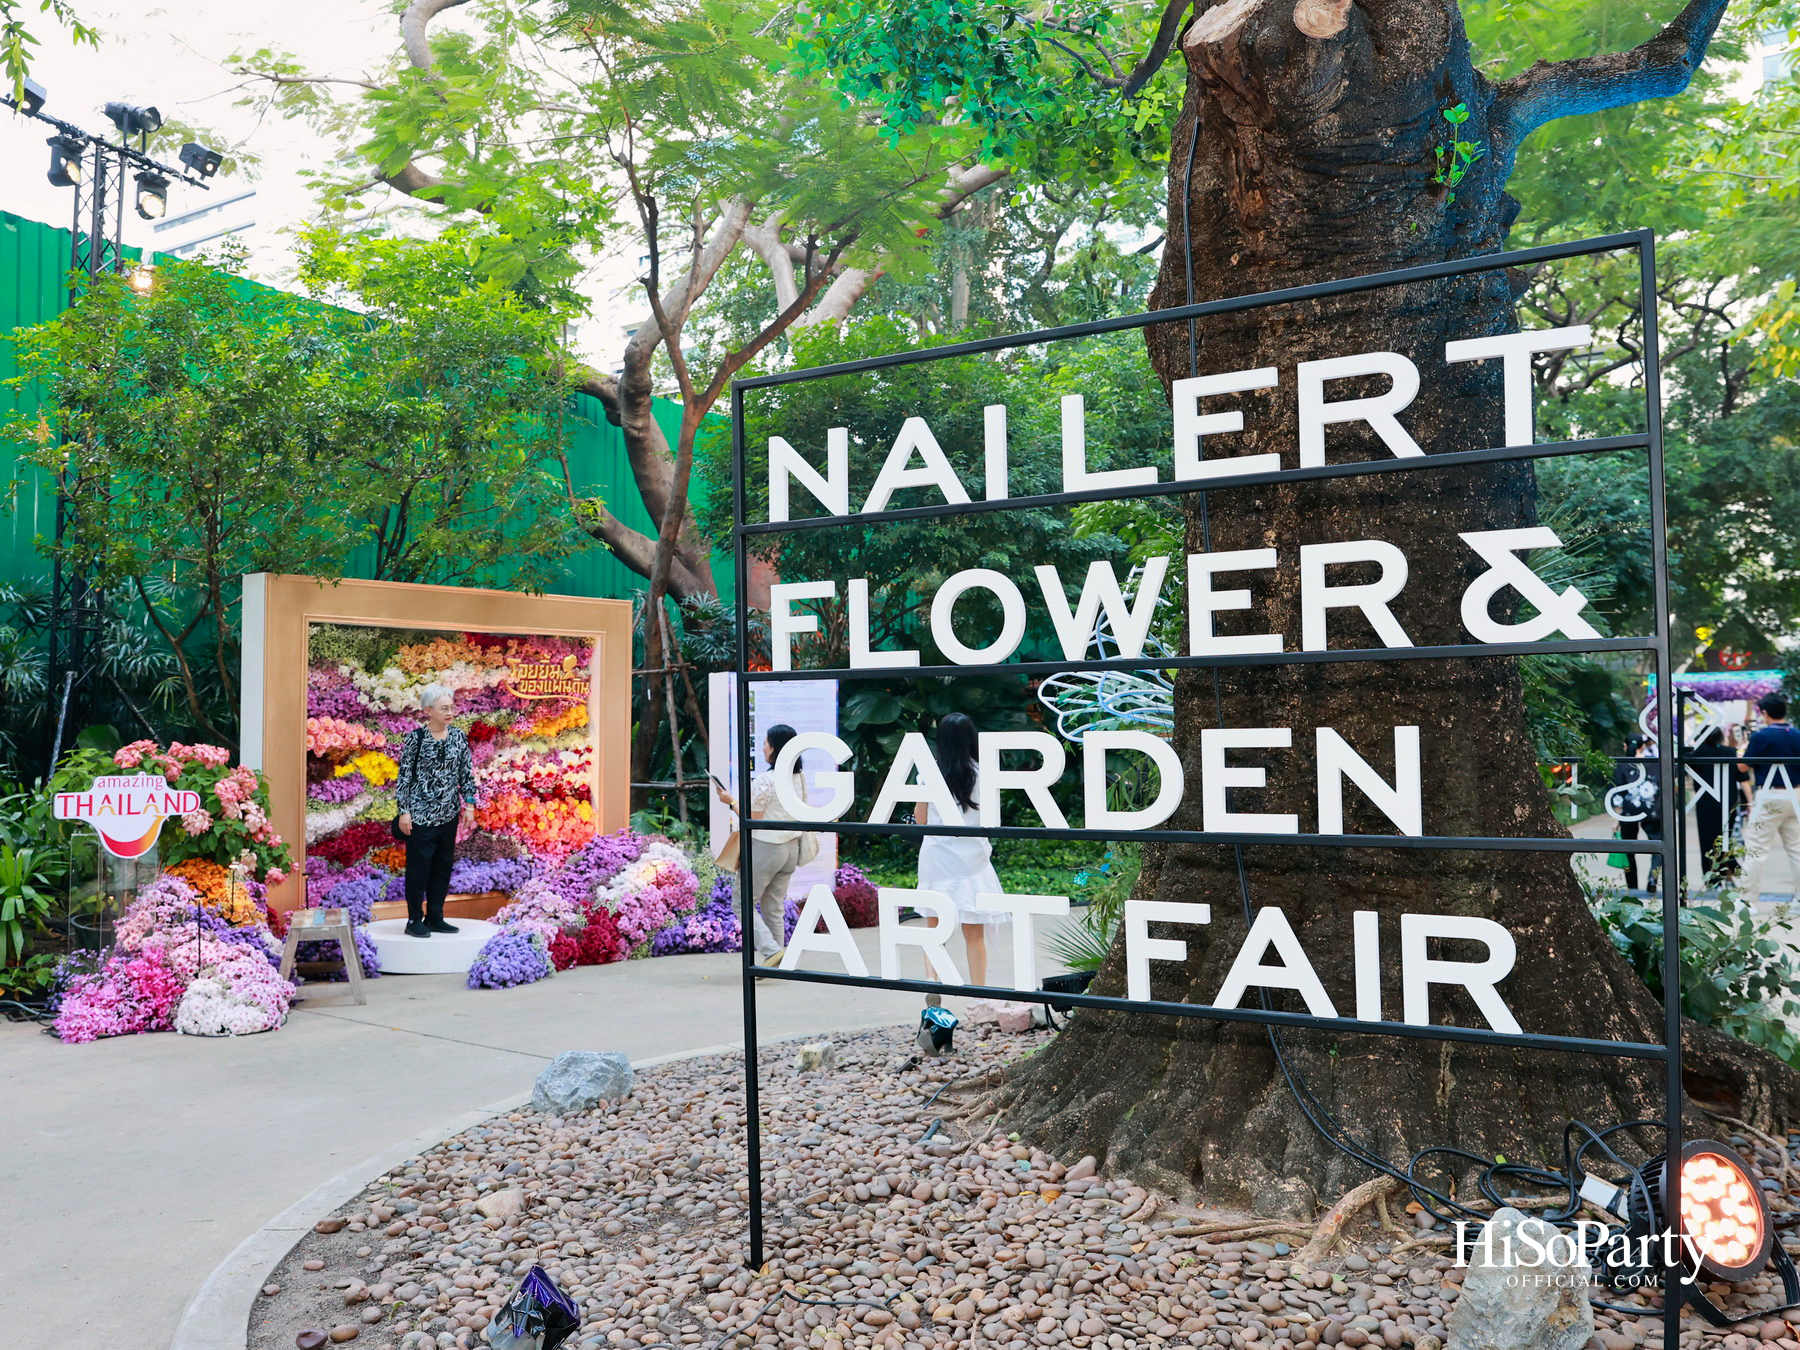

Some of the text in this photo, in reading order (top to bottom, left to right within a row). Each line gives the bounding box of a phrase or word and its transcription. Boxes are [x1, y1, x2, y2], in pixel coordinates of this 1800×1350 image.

[768, 324, 1592, 523] NAI LERT
[770, 526, 1604, 671] FLOWER &
[57, 793, 200, 816] THAILAND
[98, 774, 164, 789] amazing
[774, 726, 1424, 837] GARDEN
[778, 884, 1524, 1035] ART FAIR
